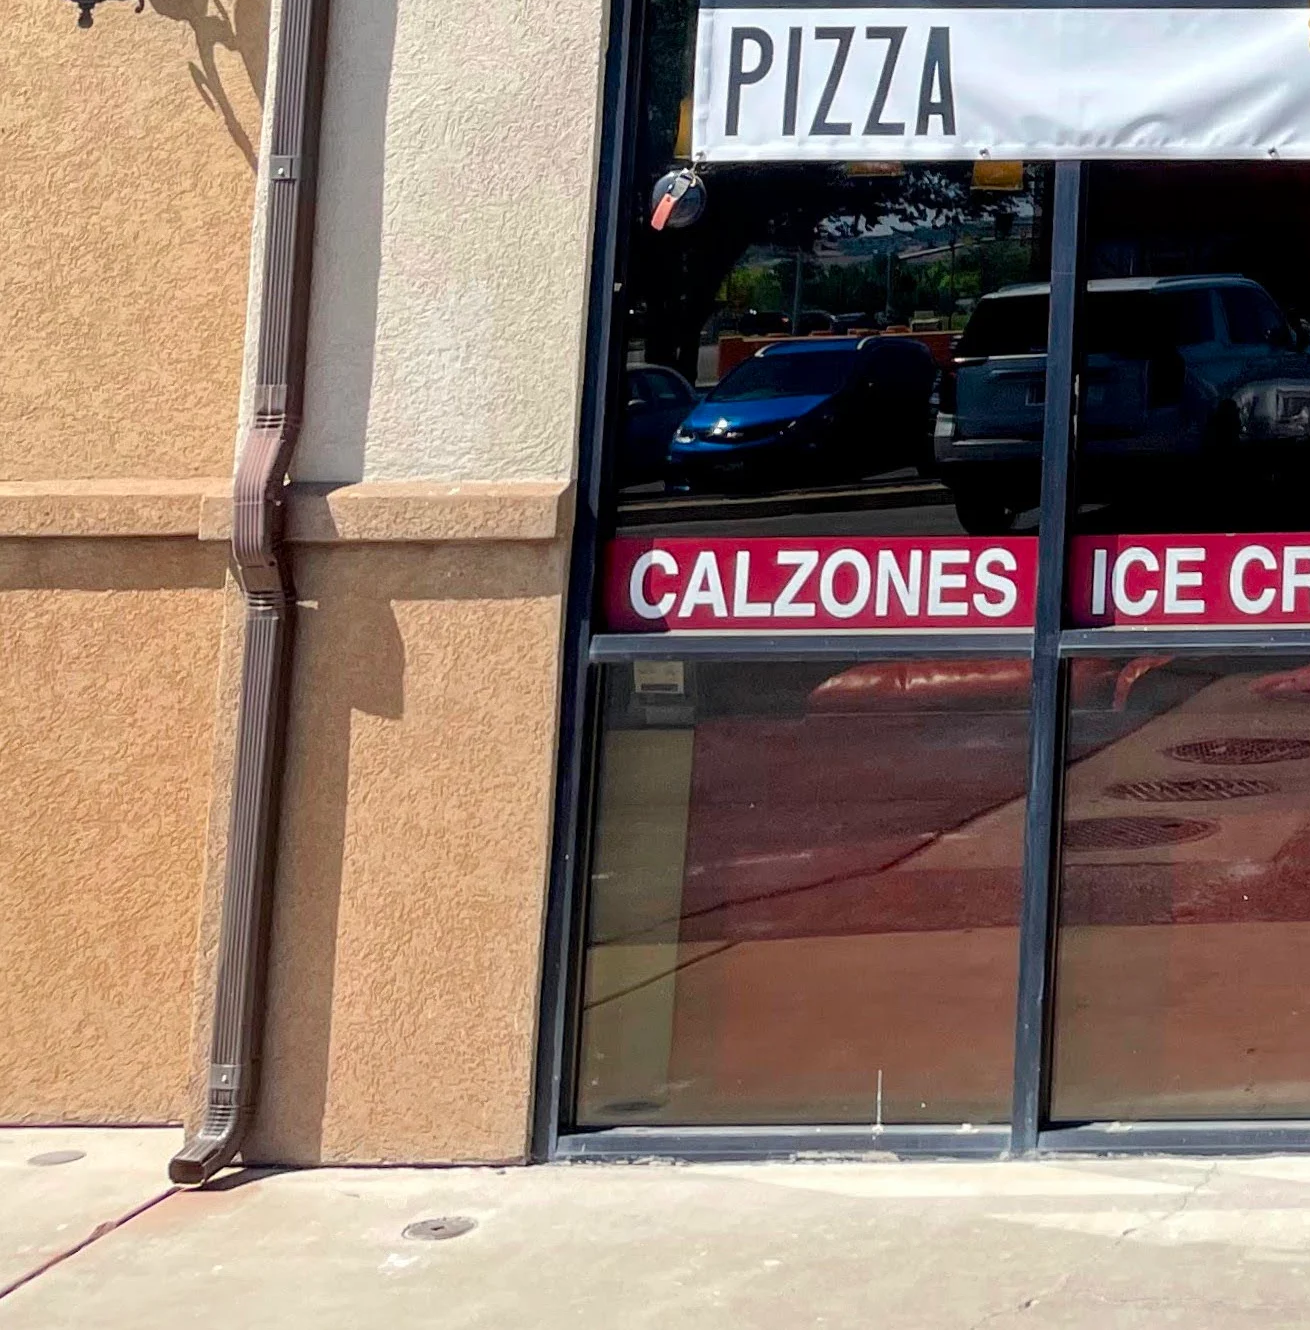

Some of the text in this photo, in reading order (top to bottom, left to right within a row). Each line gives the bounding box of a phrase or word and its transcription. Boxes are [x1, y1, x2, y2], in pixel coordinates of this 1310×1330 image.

[724, 25, 957, 137] PIZZA
[631, 547, 1017, 619] CALZONES
[1092, 546, 1206, 616] ICE
